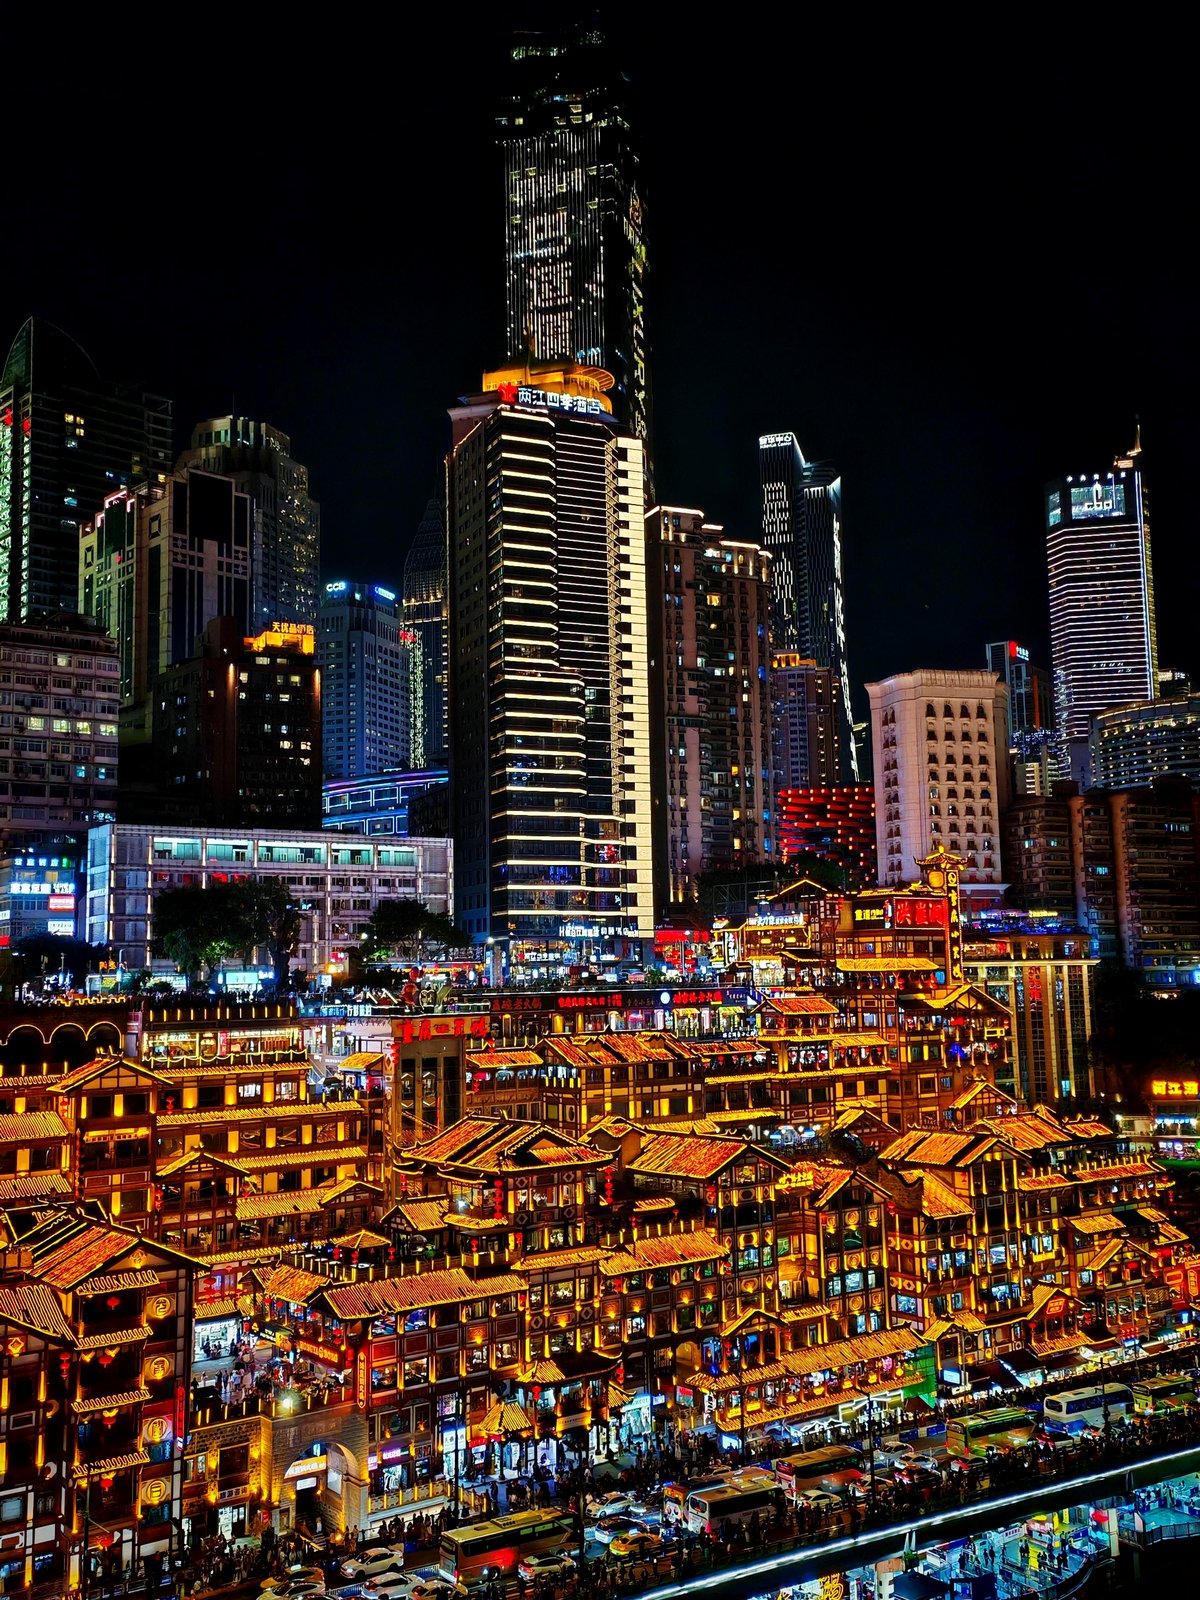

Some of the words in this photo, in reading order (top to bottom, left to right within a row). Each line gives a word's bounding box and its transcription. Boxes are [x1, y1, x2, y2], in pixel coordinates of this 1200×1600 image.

[518, 388, 600, 414] 两江四季酒店
[326, 582, 346, 592] CCB
[897, 901, 943, 925] 洪崖洞
